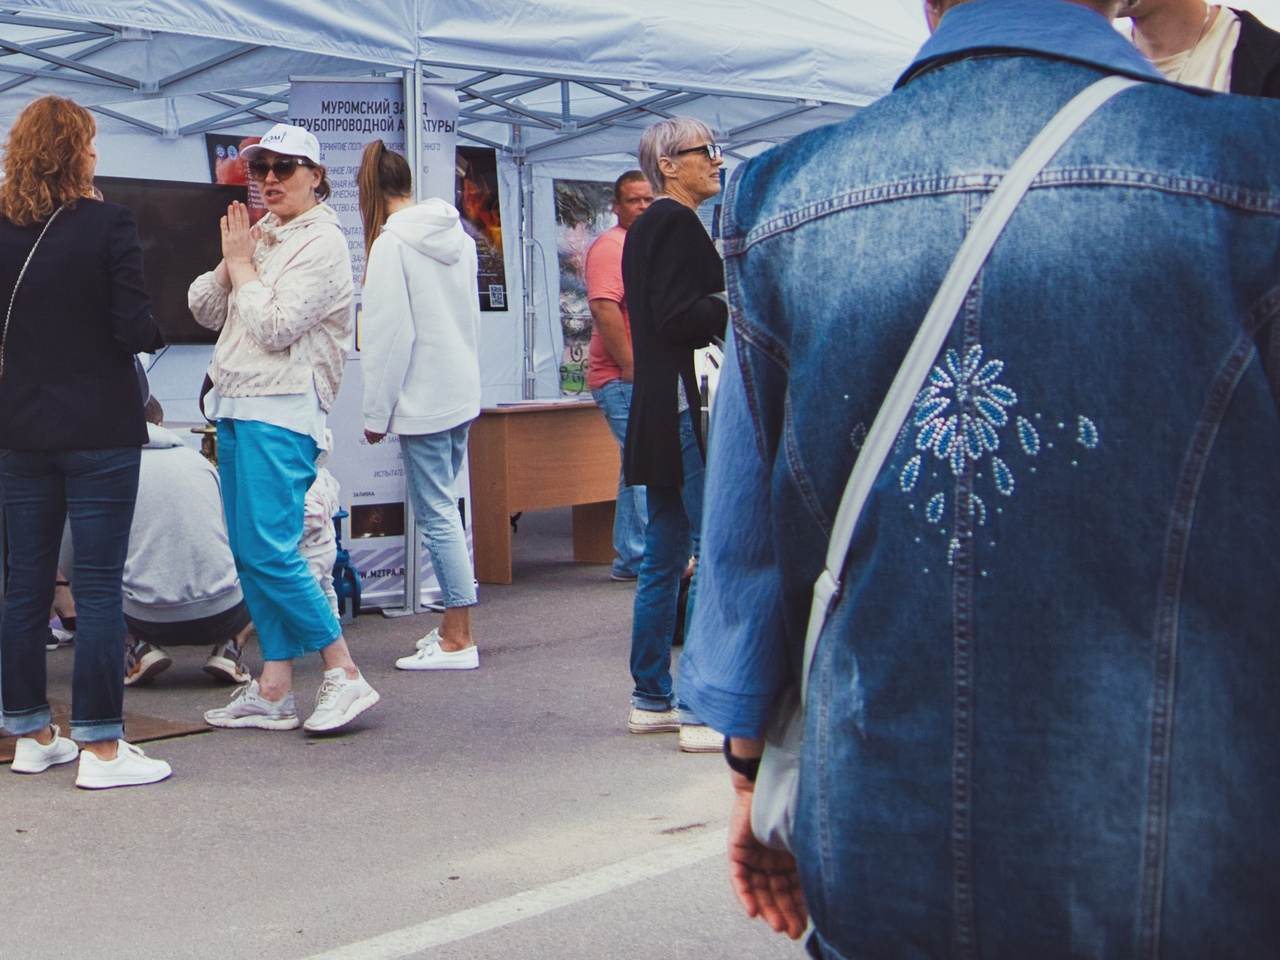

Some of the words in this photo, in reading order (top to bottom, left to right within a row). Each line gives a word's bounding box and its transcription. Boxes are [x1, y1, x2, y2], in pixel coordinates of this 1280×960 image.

[321, 98, 390, 115] МУРОМСКИЙ
[291, 116, 394, 134] ТРУБОПРОВОДНОЙ
[398, 119, 455, 133] ААТУРЫ
